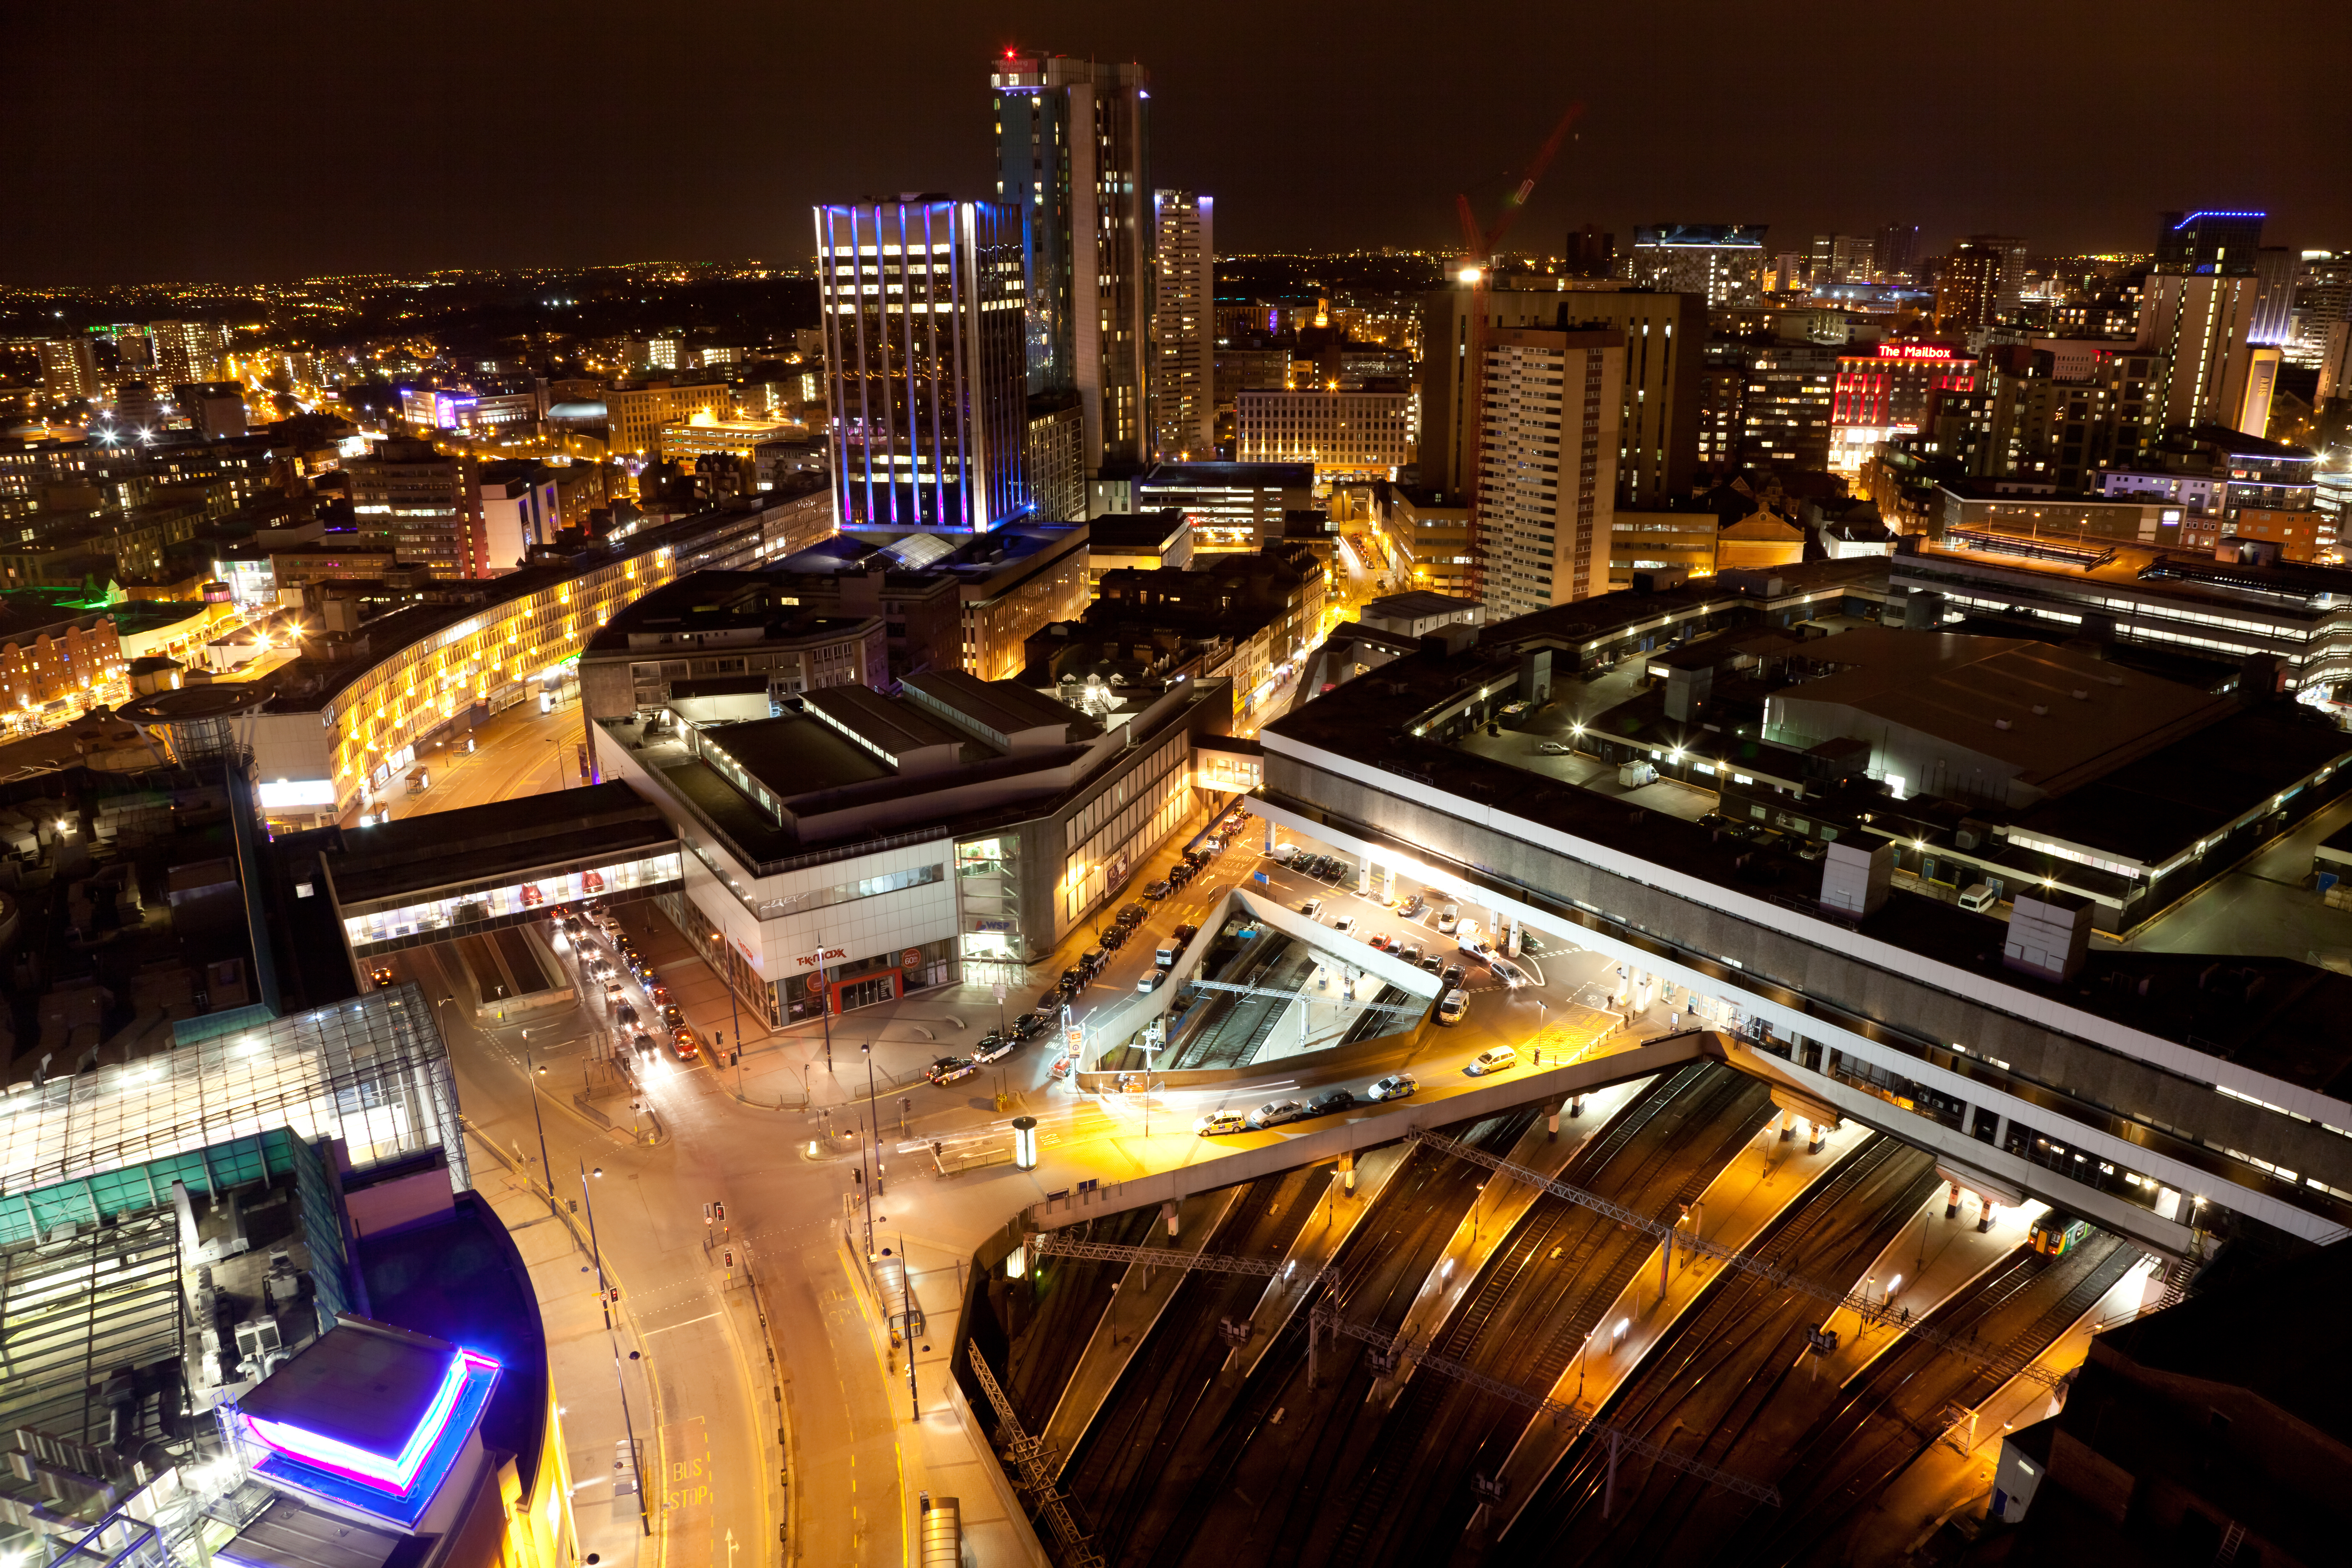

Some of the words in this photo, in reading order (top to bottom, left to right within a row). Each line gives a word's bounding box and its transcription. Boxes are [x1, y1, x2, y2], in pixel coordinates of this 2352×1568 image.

[1879, 346, 1900, 356] The
[1904, 346, 1951, 358] Mailbox
[2257, 376, 2269, 397] AXIS
[1226, 854, 1256, 862] SHORT
[986, 921, 1010, 930] WSP
[673, 1458, 702, 1482] BUS
[670, 1485, 707, 1510] STOP
